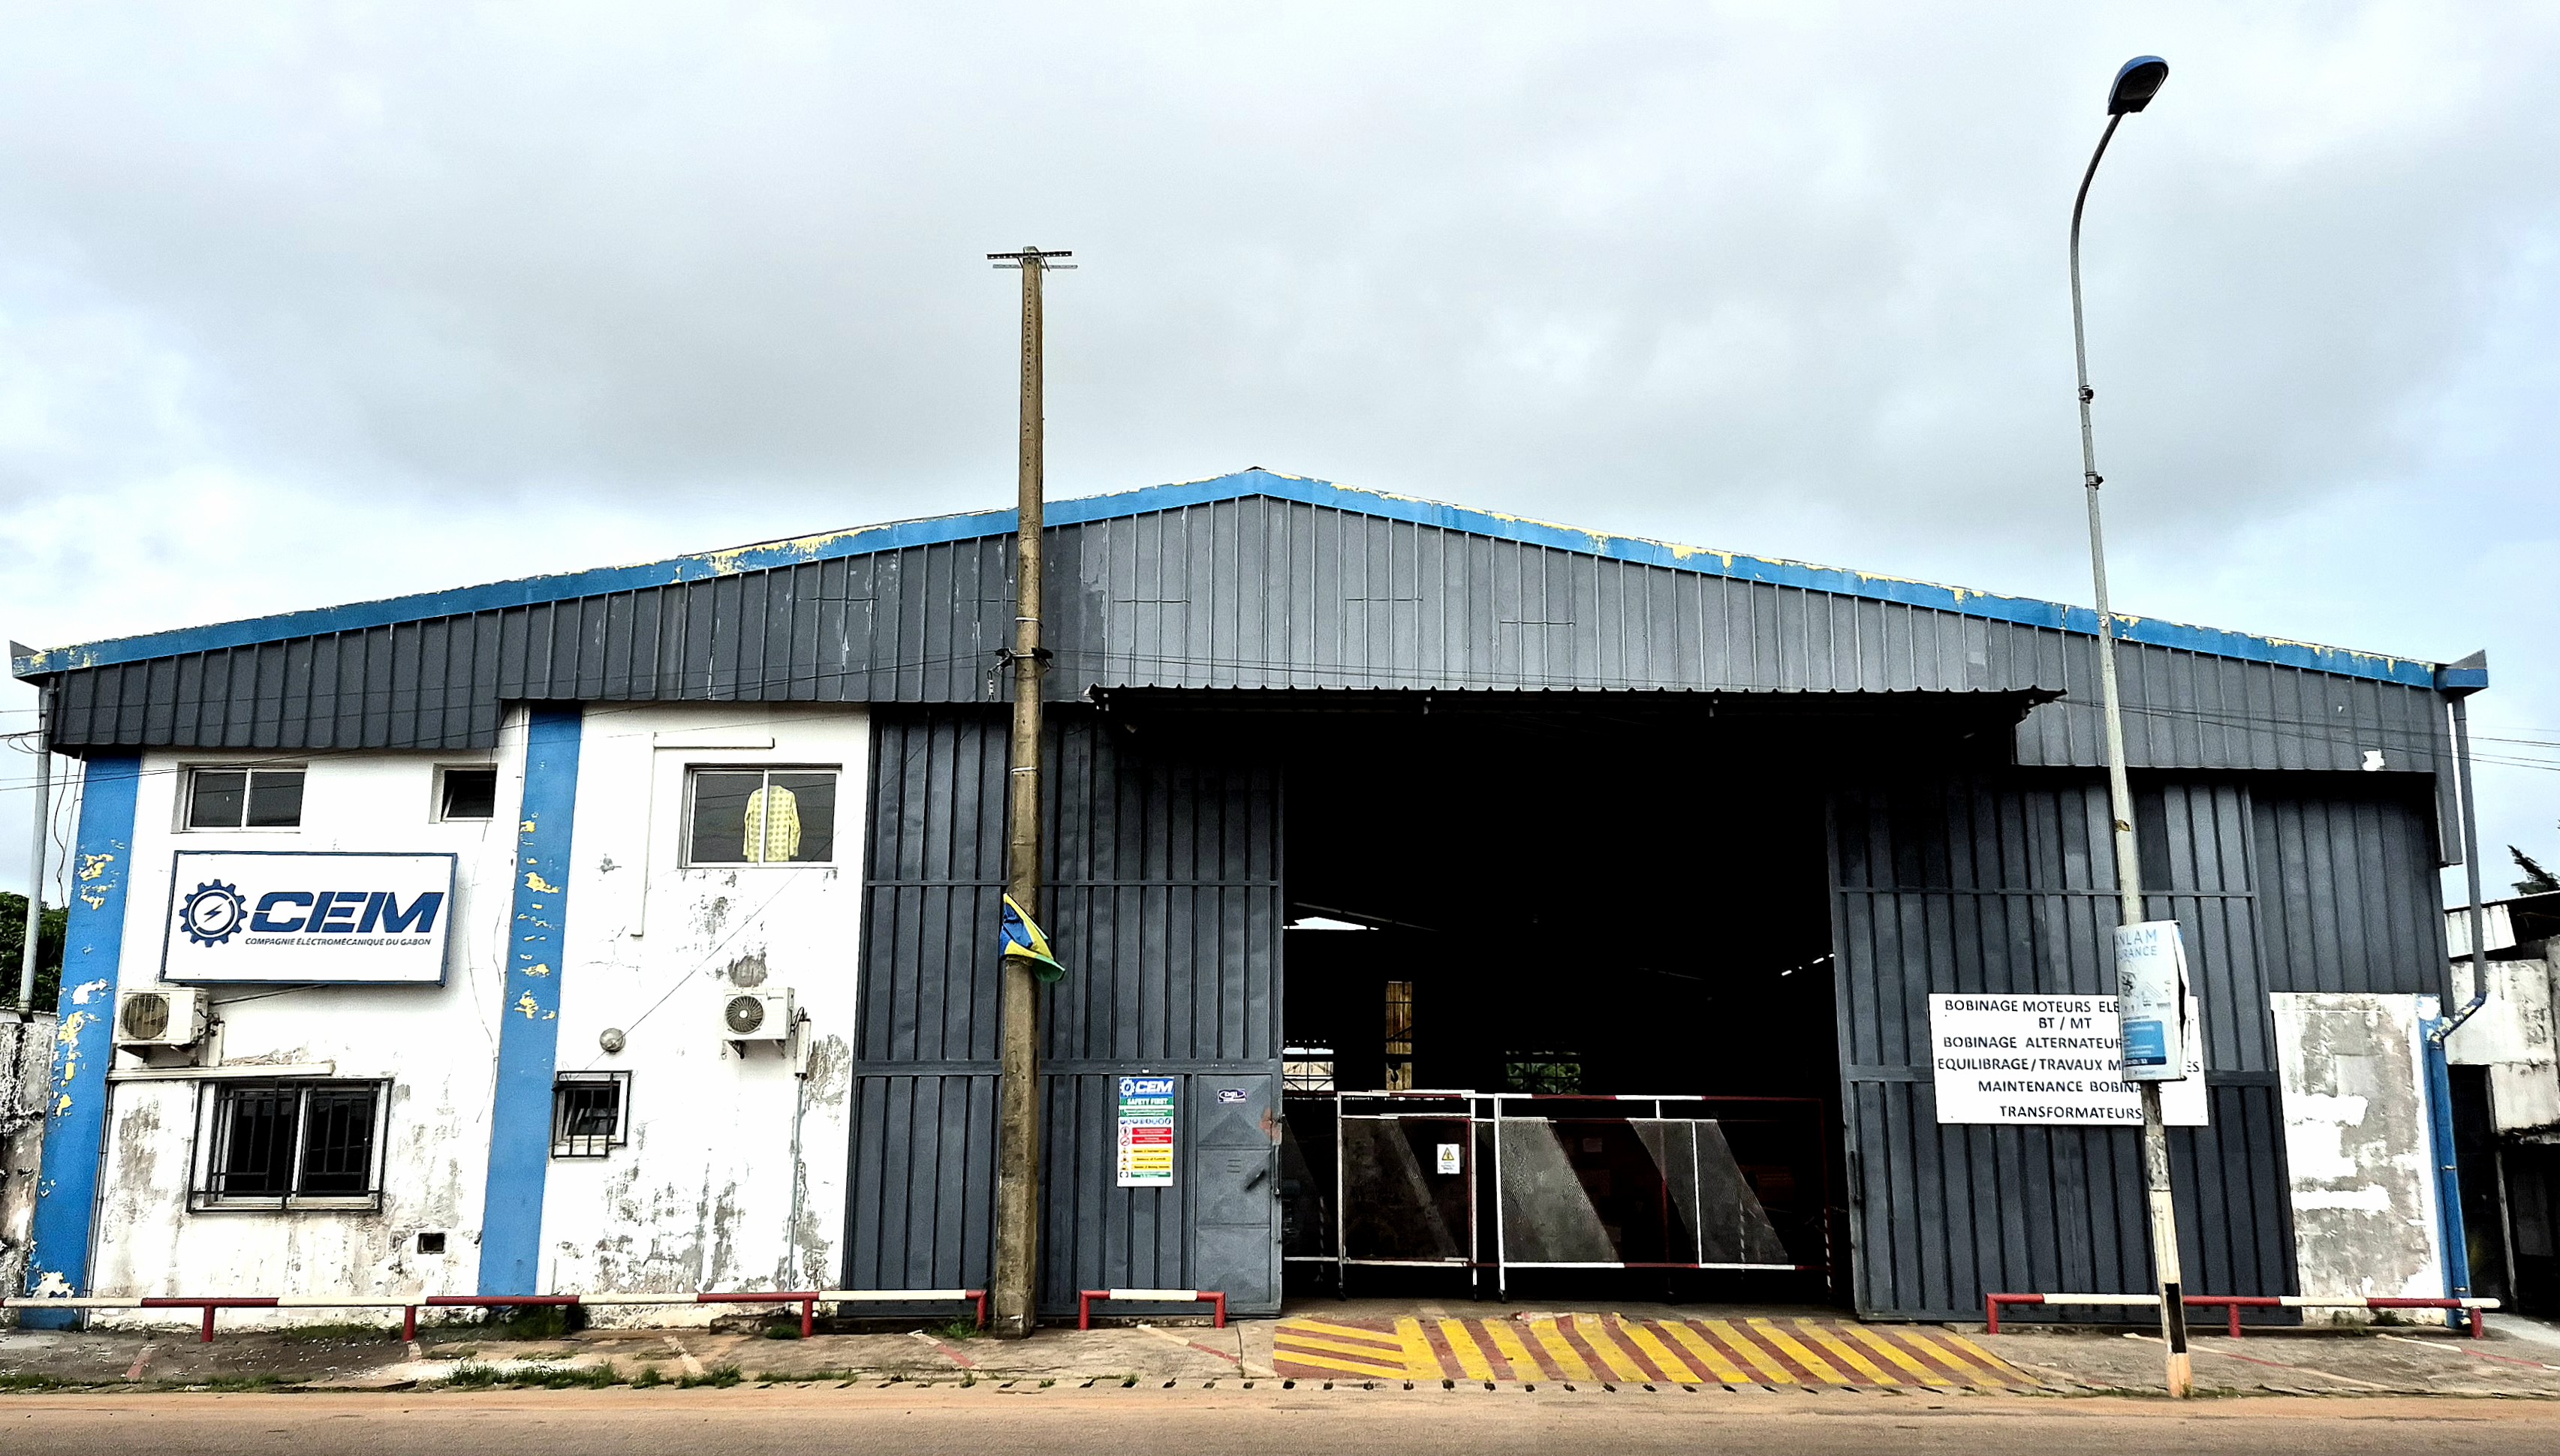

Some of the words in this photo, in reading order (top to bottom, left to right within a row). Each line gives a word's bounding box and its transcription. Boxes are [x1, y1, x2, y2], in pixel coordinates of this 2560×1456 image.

[250, 892, 444, 933] CEM
[245, 937, 295, 946] COMPAGNIE
[1944, 1000, 2018, 1012] BOBINAGE
[2023, 1000, 2091, 1012] MOTEURS
[2038, 1017, 2055, 1028] BT
[2059, 1016, 2065, 1030] /
[2071, 1017, 2092, 1029] MT
[1944, 1036, 2017, 1048] BOBINAGE
[2025, 1037, 2123, 1049] ALTERNATEUR
[1135, 1081, 1173, 1093] CEM
[1978, 1081, 2083, 1093] MAINTENANCE
[1999, 1106, 2143, 1119] TRANSFORMATEURS
